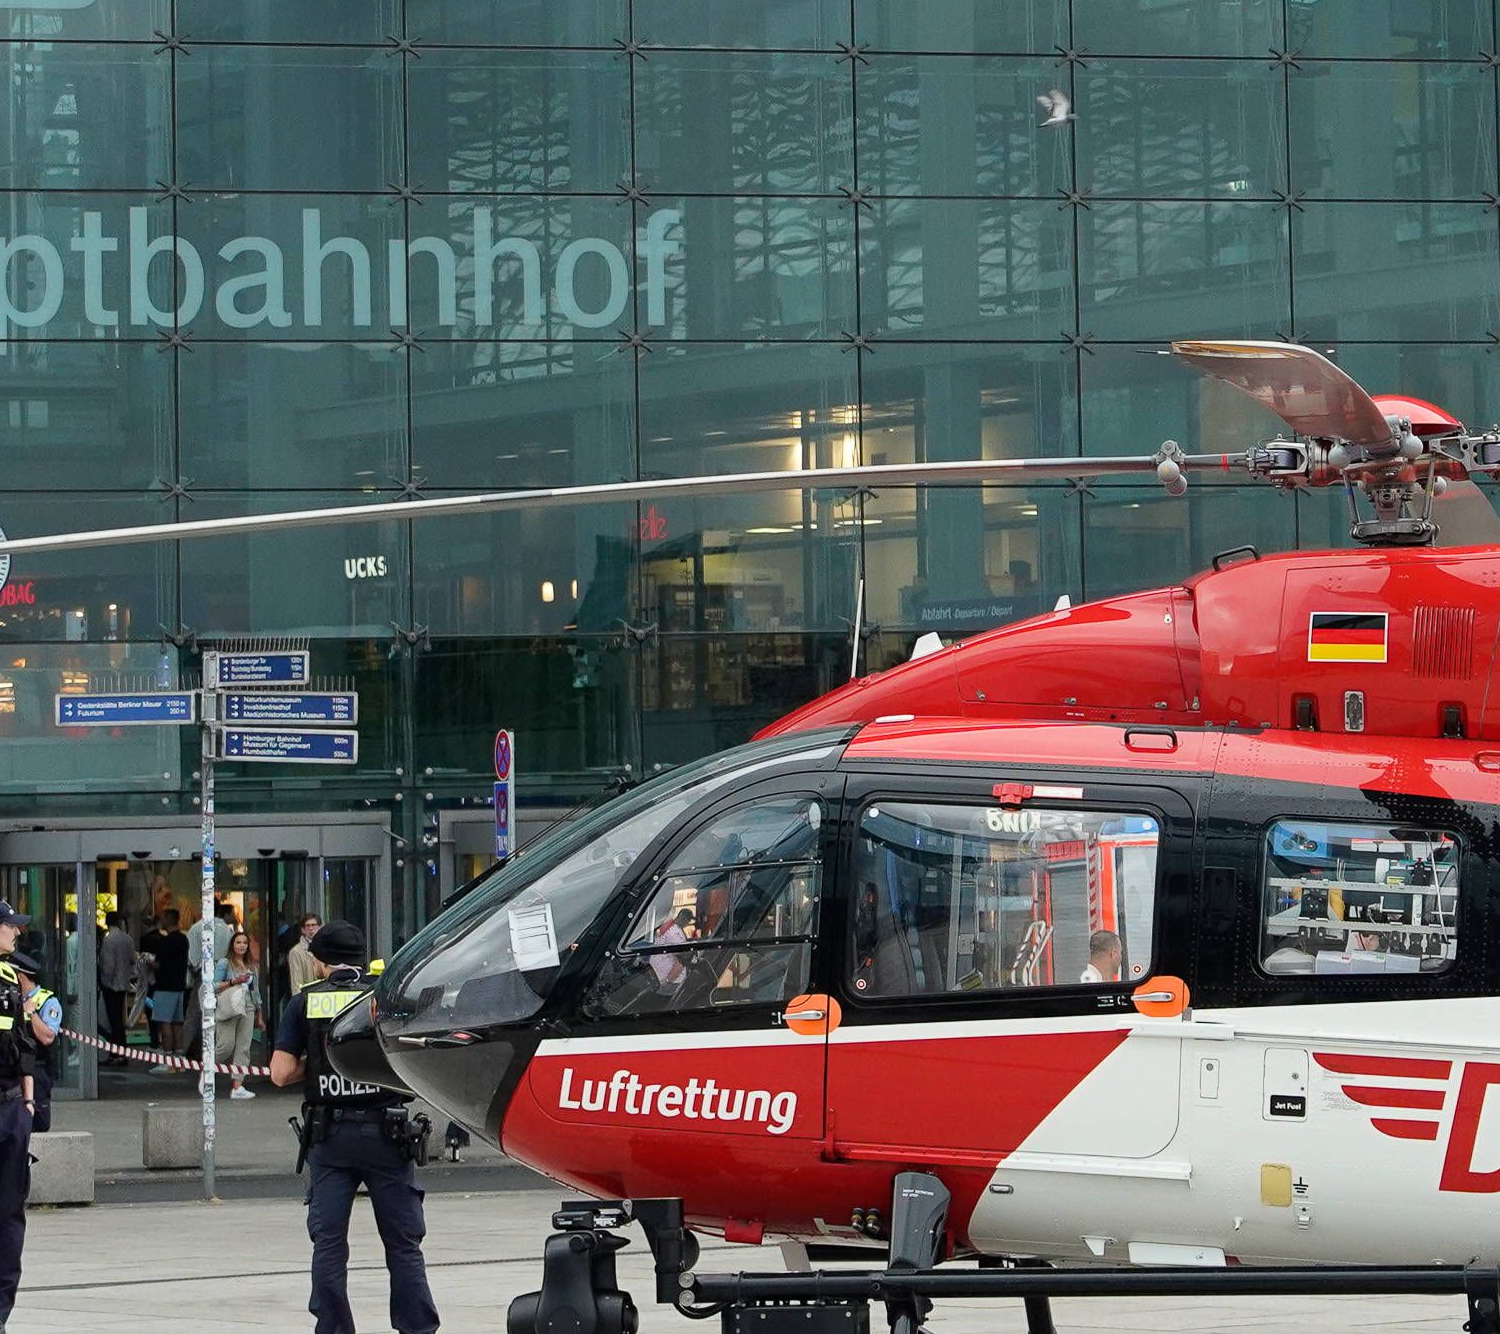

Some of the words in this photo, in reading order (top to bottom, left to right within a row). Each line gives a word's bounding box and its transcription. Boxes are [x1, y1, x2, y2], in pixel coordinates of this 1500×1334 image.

[319, 1074, 380, 1096] POLIZ
[558, 1068, 797, 1135] Luftrettung
[1274, 1102, 1286, 1110] Jet
[1286, 1102, 1302, 1110] Fuel
